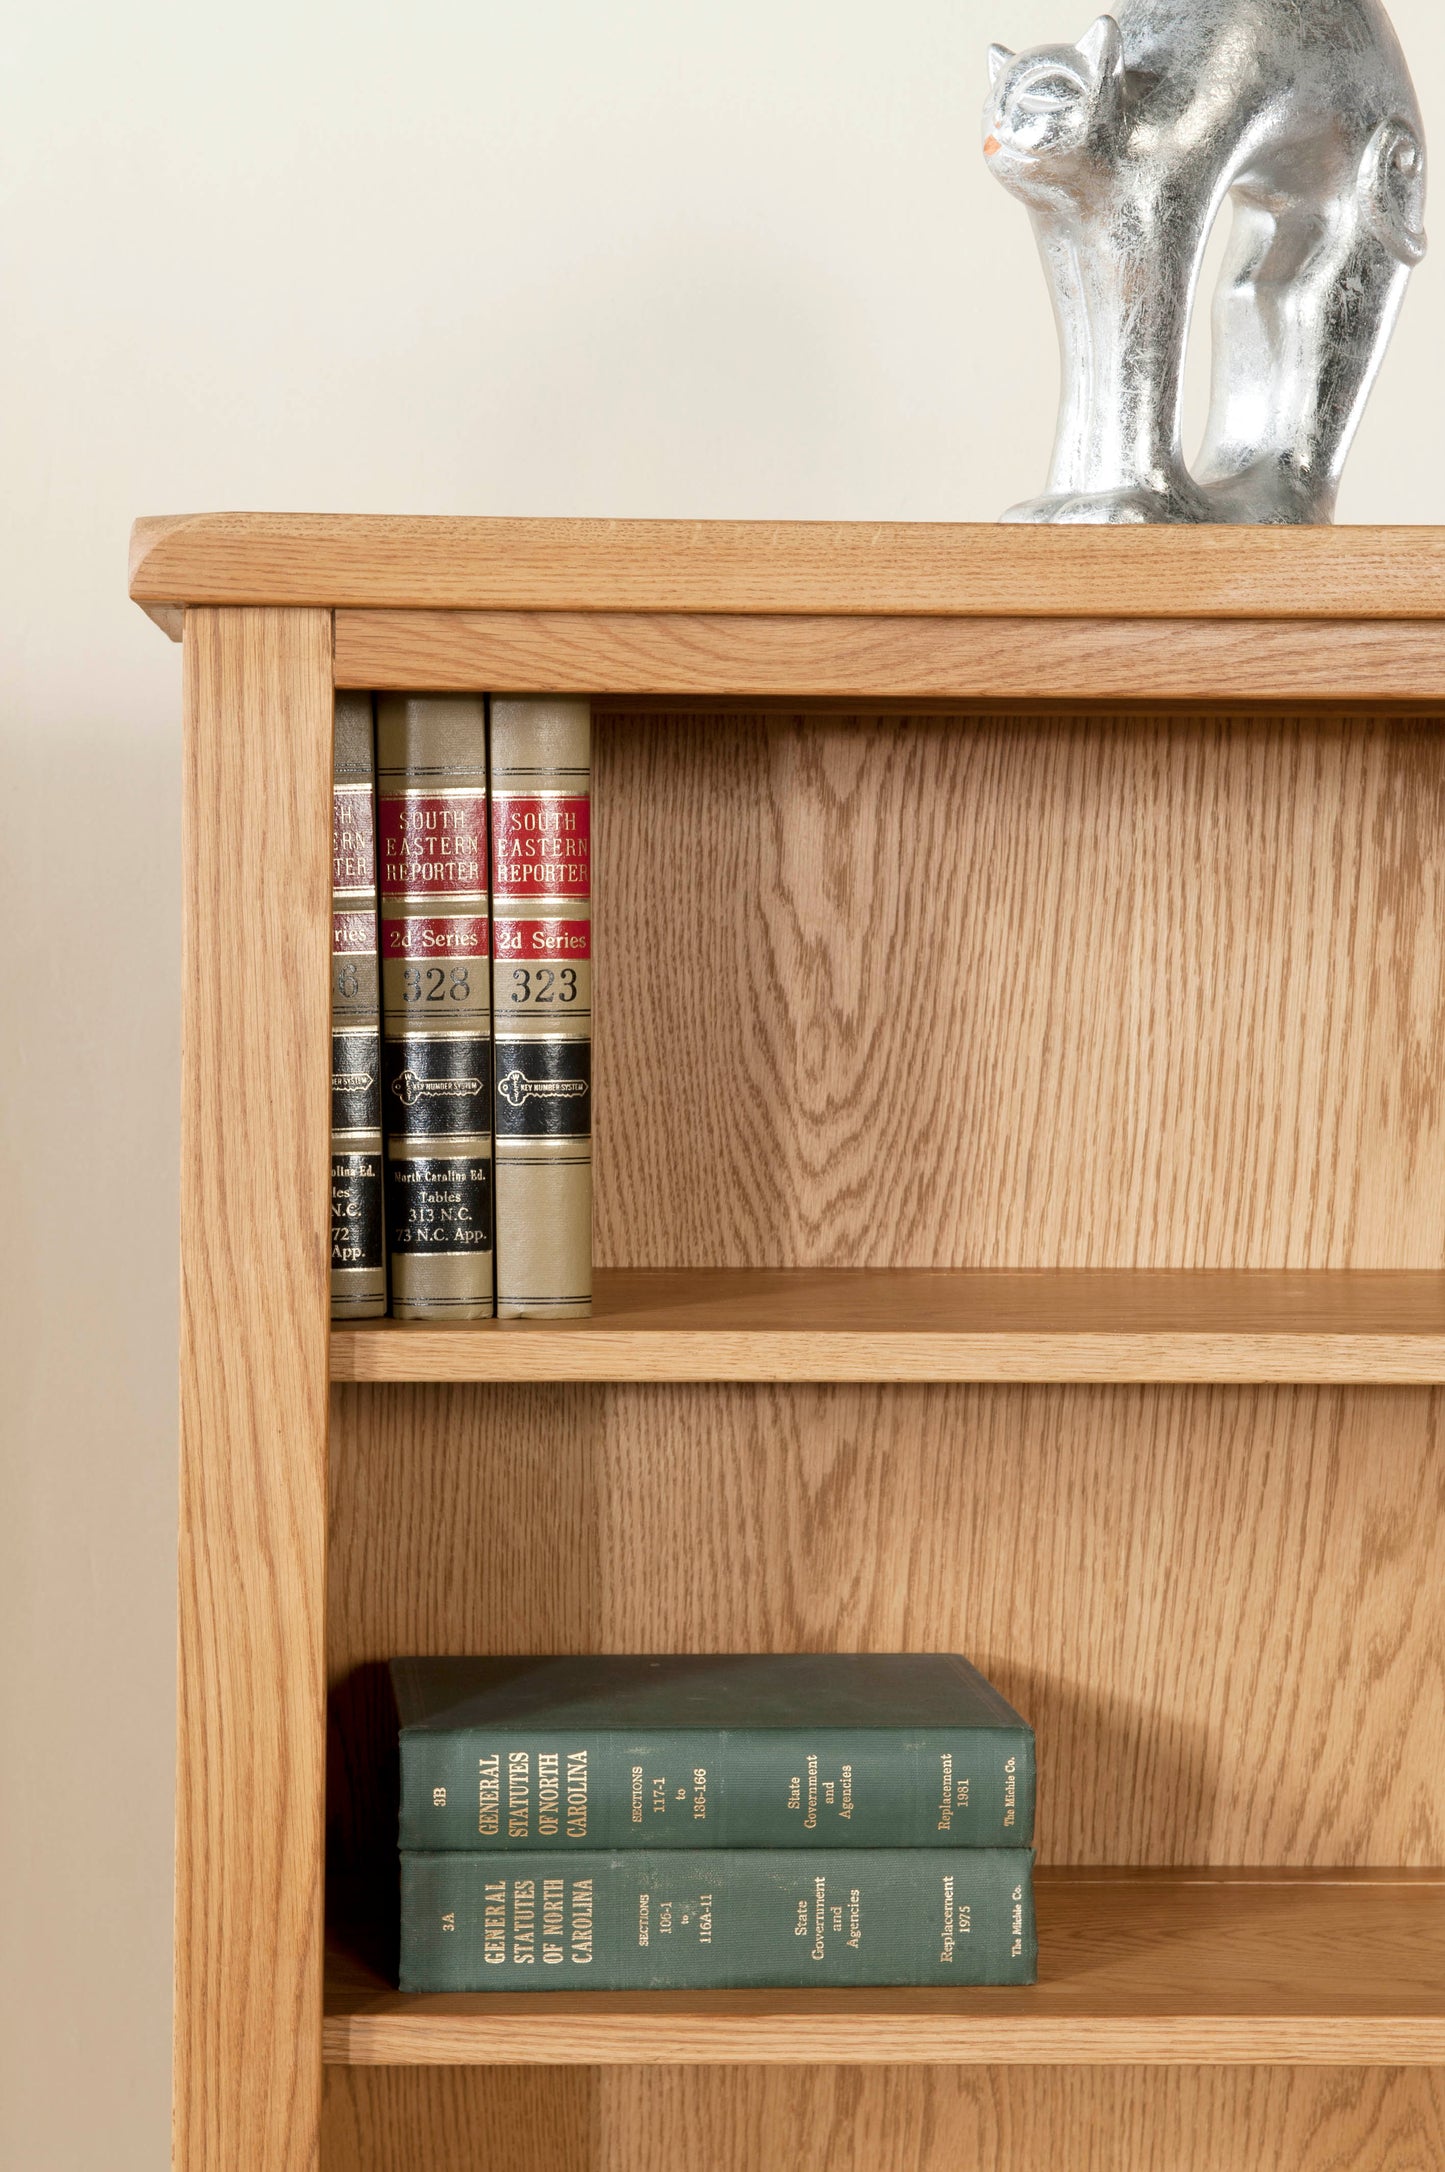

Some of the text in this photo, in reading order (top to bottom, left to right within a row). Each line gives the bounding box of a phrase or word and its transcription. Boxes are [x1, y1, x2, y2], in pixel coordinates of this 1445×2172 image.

[399, 810, 465, 830] SOUTH
[511, 813, 576, 831] SOUTH
[386, 837, 478, 857] EASTERN
[498, 838, 587, 858] EASTERN
[386, 862, 479, 882] REPORTER
[497, 864, 588, 883] REPORTER
[334, 923, 367, 942] ries
[390, 930, 478, 948] 2d Series
[499, 931, 586, 949] 2d Series
[403, 967, 471, 1002] 328
[511, 967, 577, 1003] 323
[359, 1165, 376, 1176] Ed.
[395, 1169, 486, 1182] North Carolina Ed.
[419, 1191, 461, 1203] Tables
[409, 1207, 472, 1222] 313 N.C.
[396, 1228, 487, 1243] 73 N.C. App.
[332, 1244, 365, 1261] App.
[433, 1786, 446, 1807] 3B
[478, 1754, 499, 1835] GENERAL
[508, 1752, 529, 1837] STATUTES
[539, 1753, 558, 1835] OF NORTH
[567, 1750, 587, 1837] CAROLINA
[632, 1766, 642, 1823] SECTIONS
[653, 1777, 665, 1812] 117-1
[676, 1789, 685, 1800] to
[694, 1768, 706, 1819] 136-166
[788, 1776, 800, 1809] State
[804, 1754, 817, 1829] Government
[823, 1782, 834, 1804] and
[839, 1765, 854, 1819] Agencies
[938, 1753, 953, 1830] Replacement
[957, 1779, 969, 1807] 1981
[1004, 1757, 1016, 1827] The Michie Co.
[442, 1913, 454, 1931] 3A
[485, 1880, 506, 1963] GENERAL
[514, 1880, 534, 1963] STATUTES
[543, 1879, 564, 1964] OF NORTH
[572, 1879, 592, 1963] CAROLINA
[639, 1894, 649, 1946] SECTIONS
[659, 1902, 672, 1934] 106-1
[681, 1914, 689, 1924] to
[700, 1894, 712, 1944] 116A-11
[794, 1900, 807, 1936] State
[812, 1877, 825, 1961] Government
[831, 1906, 842, 1931] and
[847, 1889, 861, 1948] Agencies
[940, 1876, 955, 1963] Replacement
[959, 1905, 970, 1933] 1975
[1012, 1884, 1021, 1958] The Michie Co.
